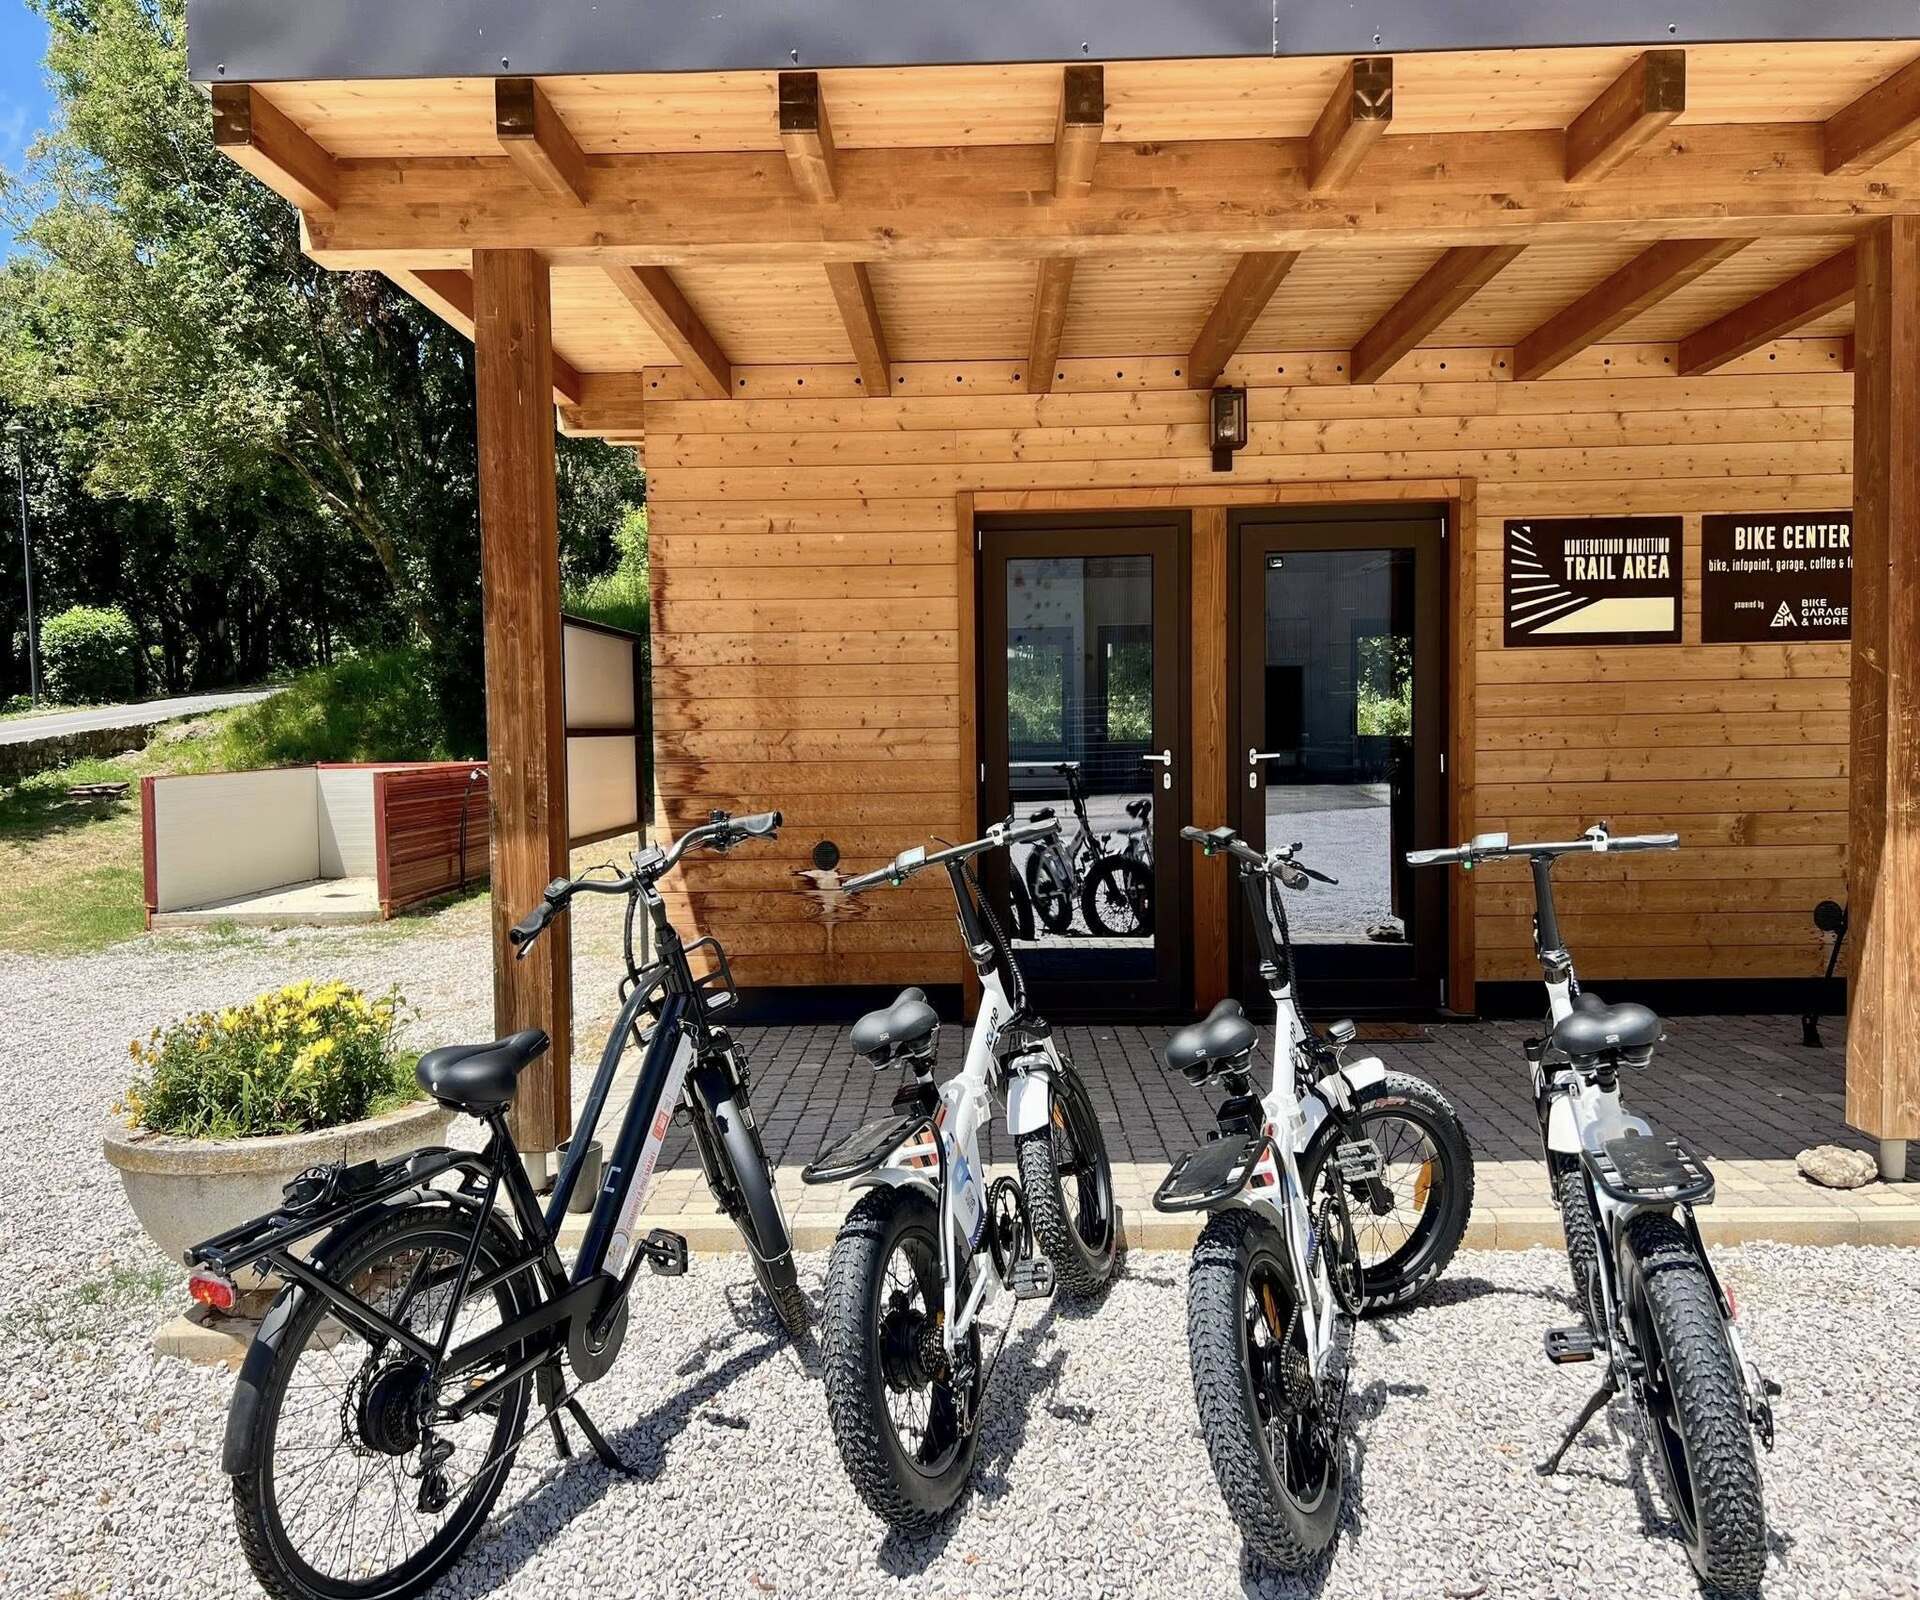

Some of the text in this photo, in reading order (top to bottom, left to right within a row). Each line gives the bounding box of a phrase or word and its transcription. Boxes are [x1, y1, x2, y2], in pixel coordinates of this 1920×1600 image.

[1626, 537, 1670, 554] MARITTIMO
[1735, 524, 1850, 550] BIKE CENTER
[1564, 554, 1670, 580] TRAIL AREA
[1709, 559, 1730, 572] bike,
[1732, 558, 1773, 573] infopoint,
[1776, 560, 1807, 573] garage,
[1810, 556, 1836, 569] coffee
[1839, 558, 1845, 569] &
[1801, 598, 1827, 607] BIKE
[1801, 607, 1849, 617] GARAGE
[1801, 616, 1848, 626] & MORE
